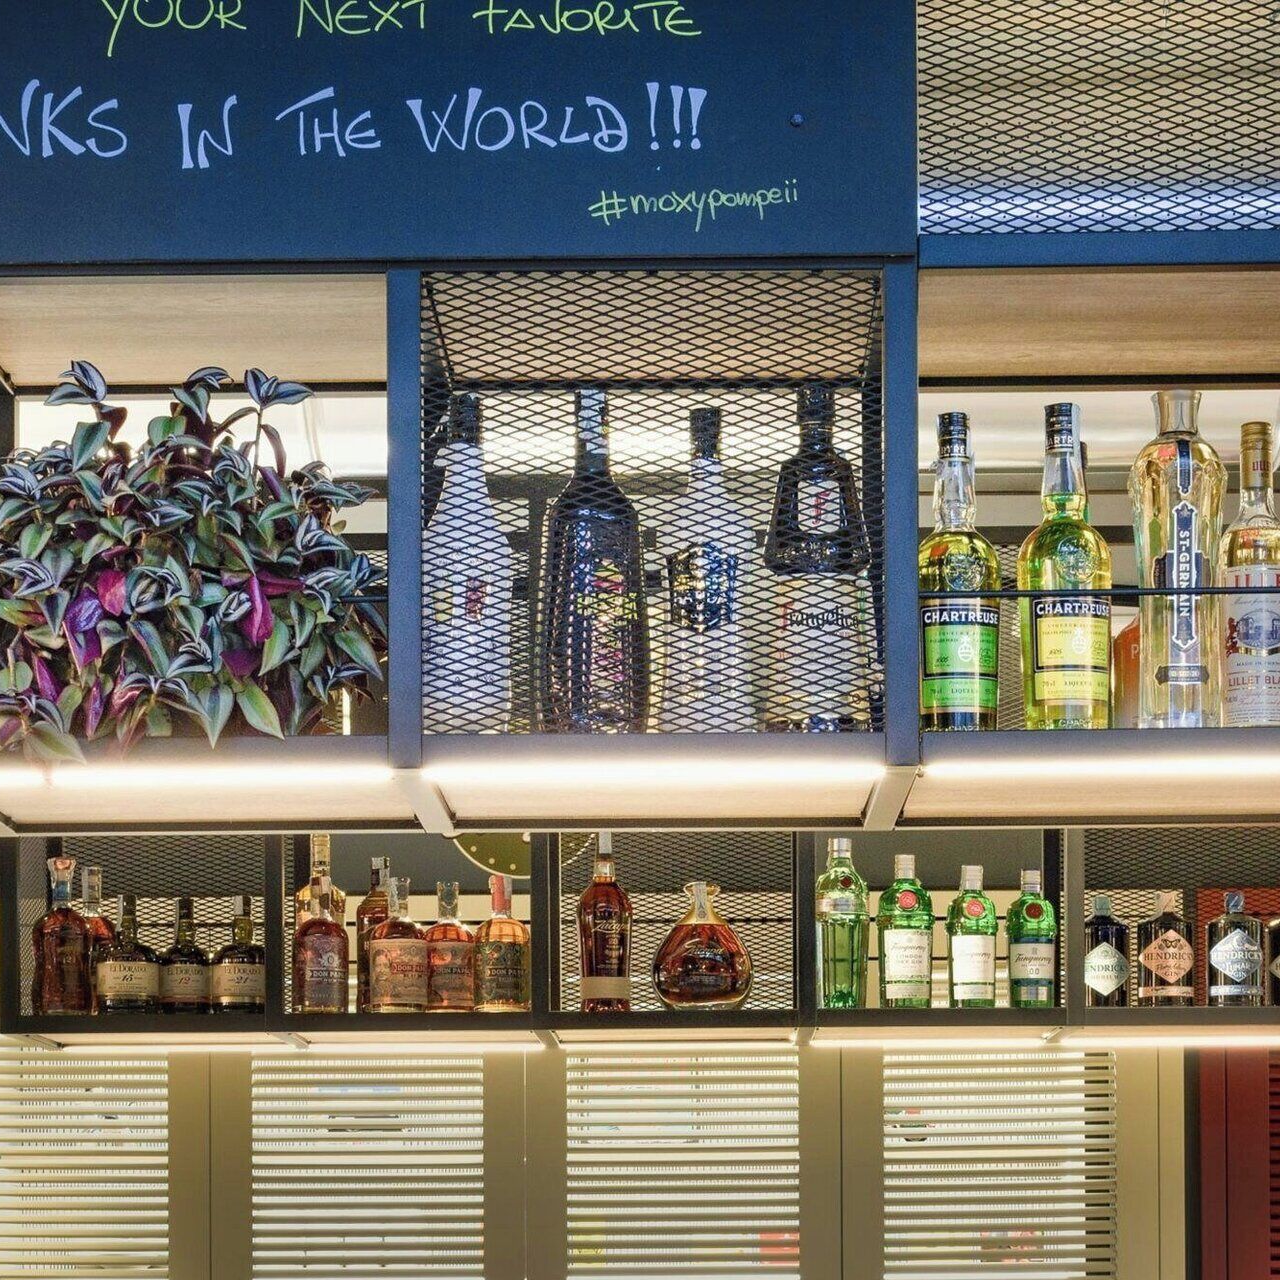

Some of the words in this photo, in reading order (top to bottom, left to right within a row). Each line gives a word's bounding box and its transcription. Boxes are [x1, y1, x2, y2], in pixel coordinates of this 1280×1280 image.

[177, 94, 238, 170] IN
[274, 86, 382, 158] THE
[587, 178, 798, 233] #moxypompeii
[1037, 602, 1109, 617] CHARTREUSE
[924, 610, 998, 625] CHARTREUSE
[1228, 676, 1260, 688] LILLET
